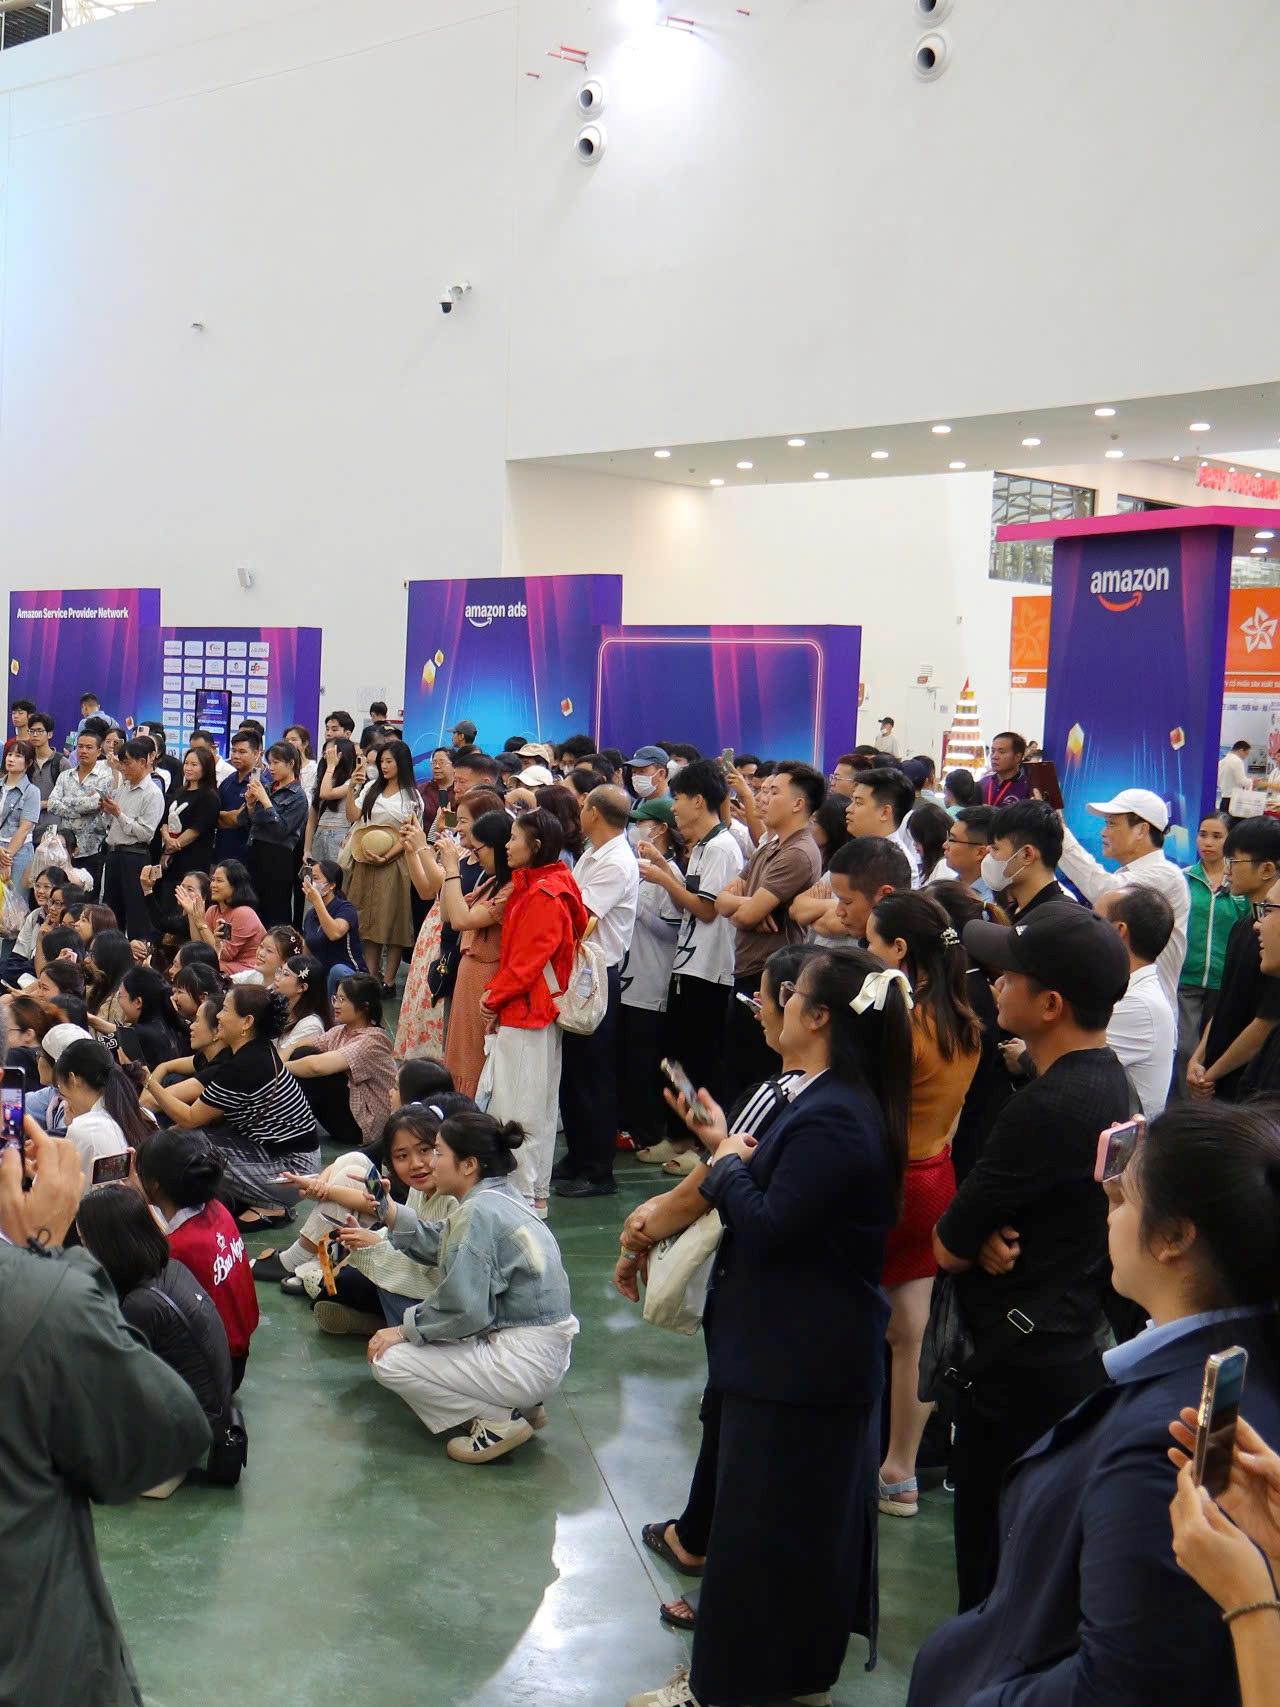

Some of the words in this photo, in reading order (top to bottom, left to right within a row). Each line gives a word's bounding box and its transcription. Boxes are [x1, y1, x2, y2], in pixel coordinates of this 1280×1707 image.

[1090, 566, 1170, 594] amazon
[16, 608, 43, 619] Amazon
[43, 608, 67, 619] Service
[68, 608, 97, 619] Provider
[98, 606, 128, 619] Network
[465, 604, 506, 618] amazon
[507, 601, 527, 618] ads
